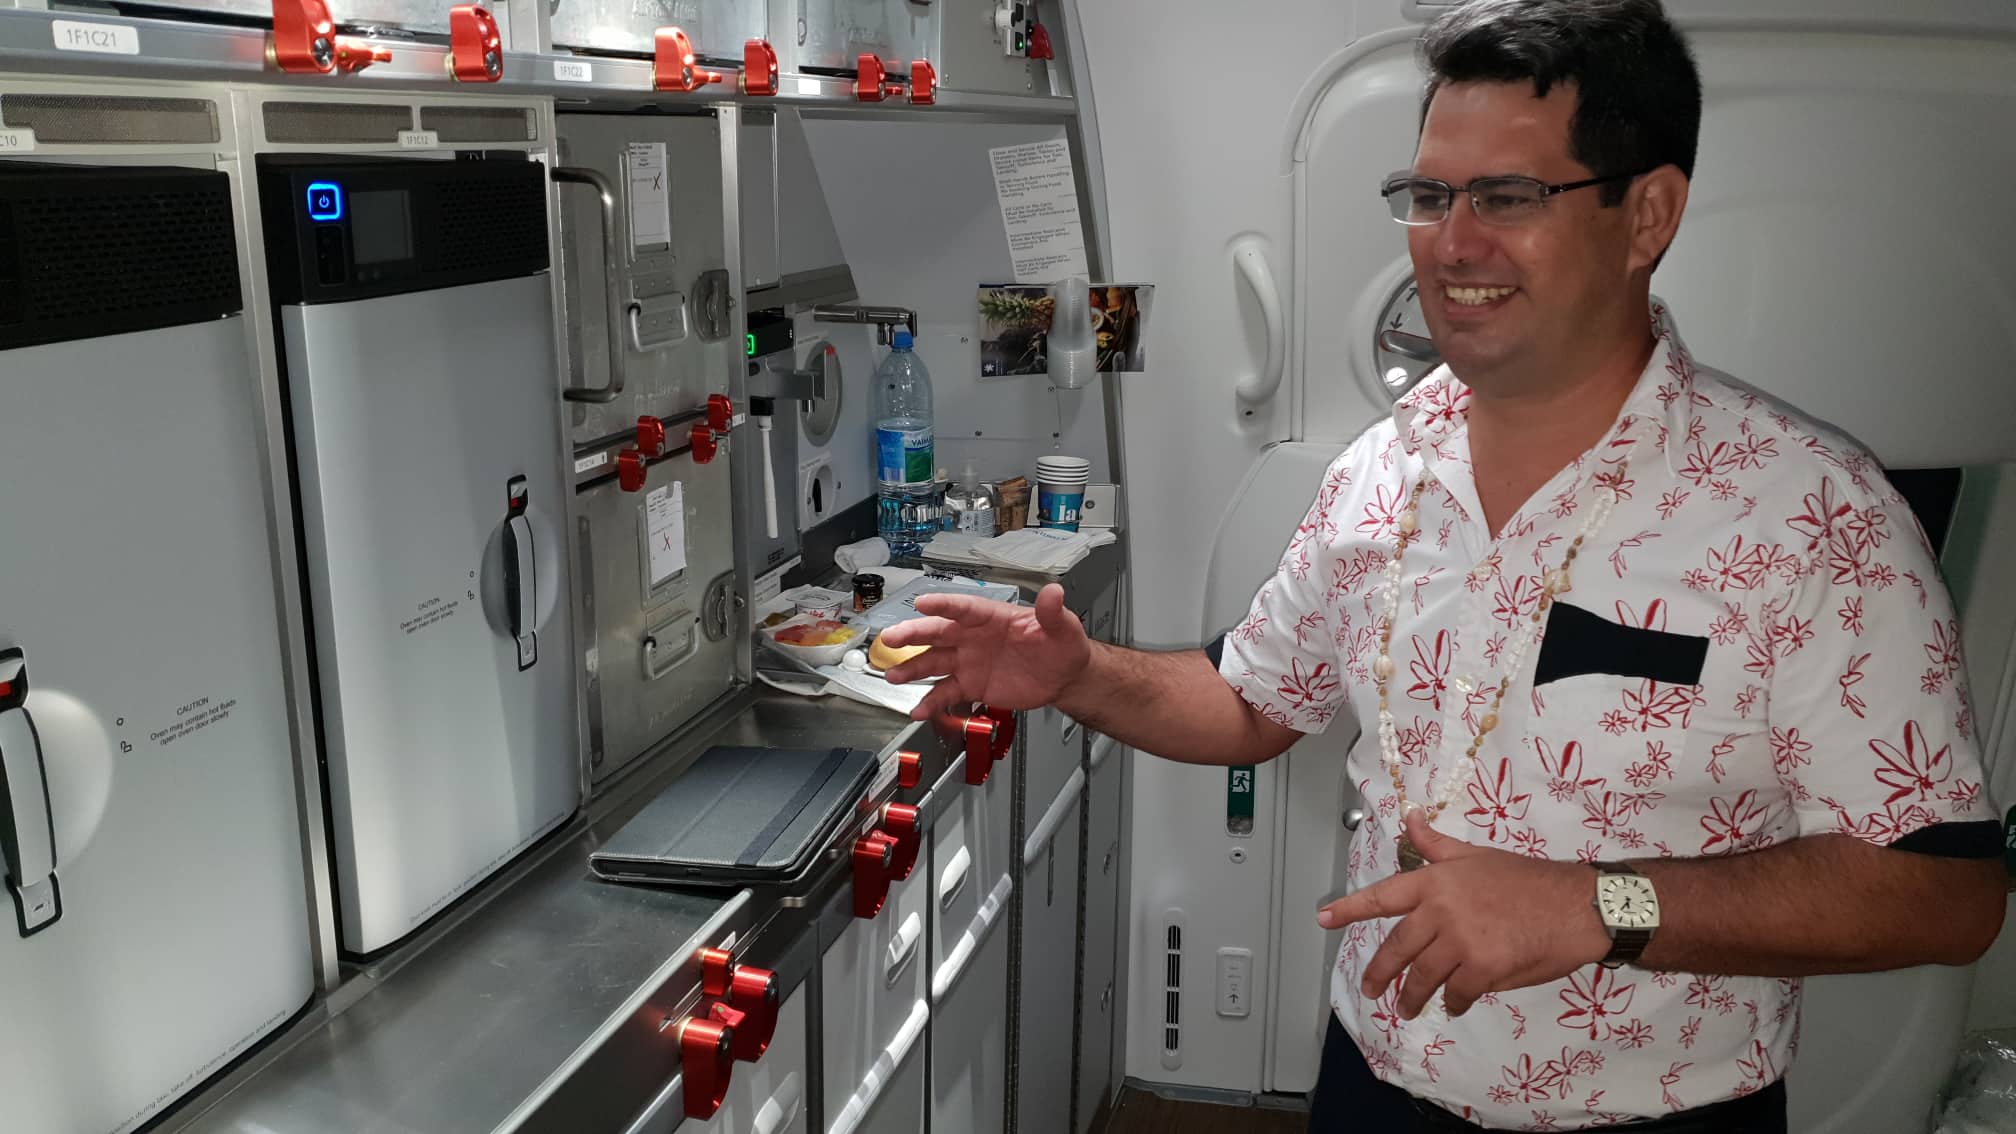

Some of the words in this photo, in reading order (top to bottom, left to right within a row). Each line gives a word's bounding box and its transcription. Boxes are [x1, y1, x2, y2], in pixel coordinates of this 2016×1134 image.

[67, 28, 117, 47] 1F1C21
[176, 696, 209, 716] CAUTION
[150, 728, 169, 741] Oven
[169, 721, 184, 734] may
[185, 711, 208, 727] contain
[208, 705, 219, 716] hot
[160, 733, 177, 746] open
[177, 726, 194, 739] oven
[195, 718, 209, 730] door
[210, 710, 230, 724] slowly
